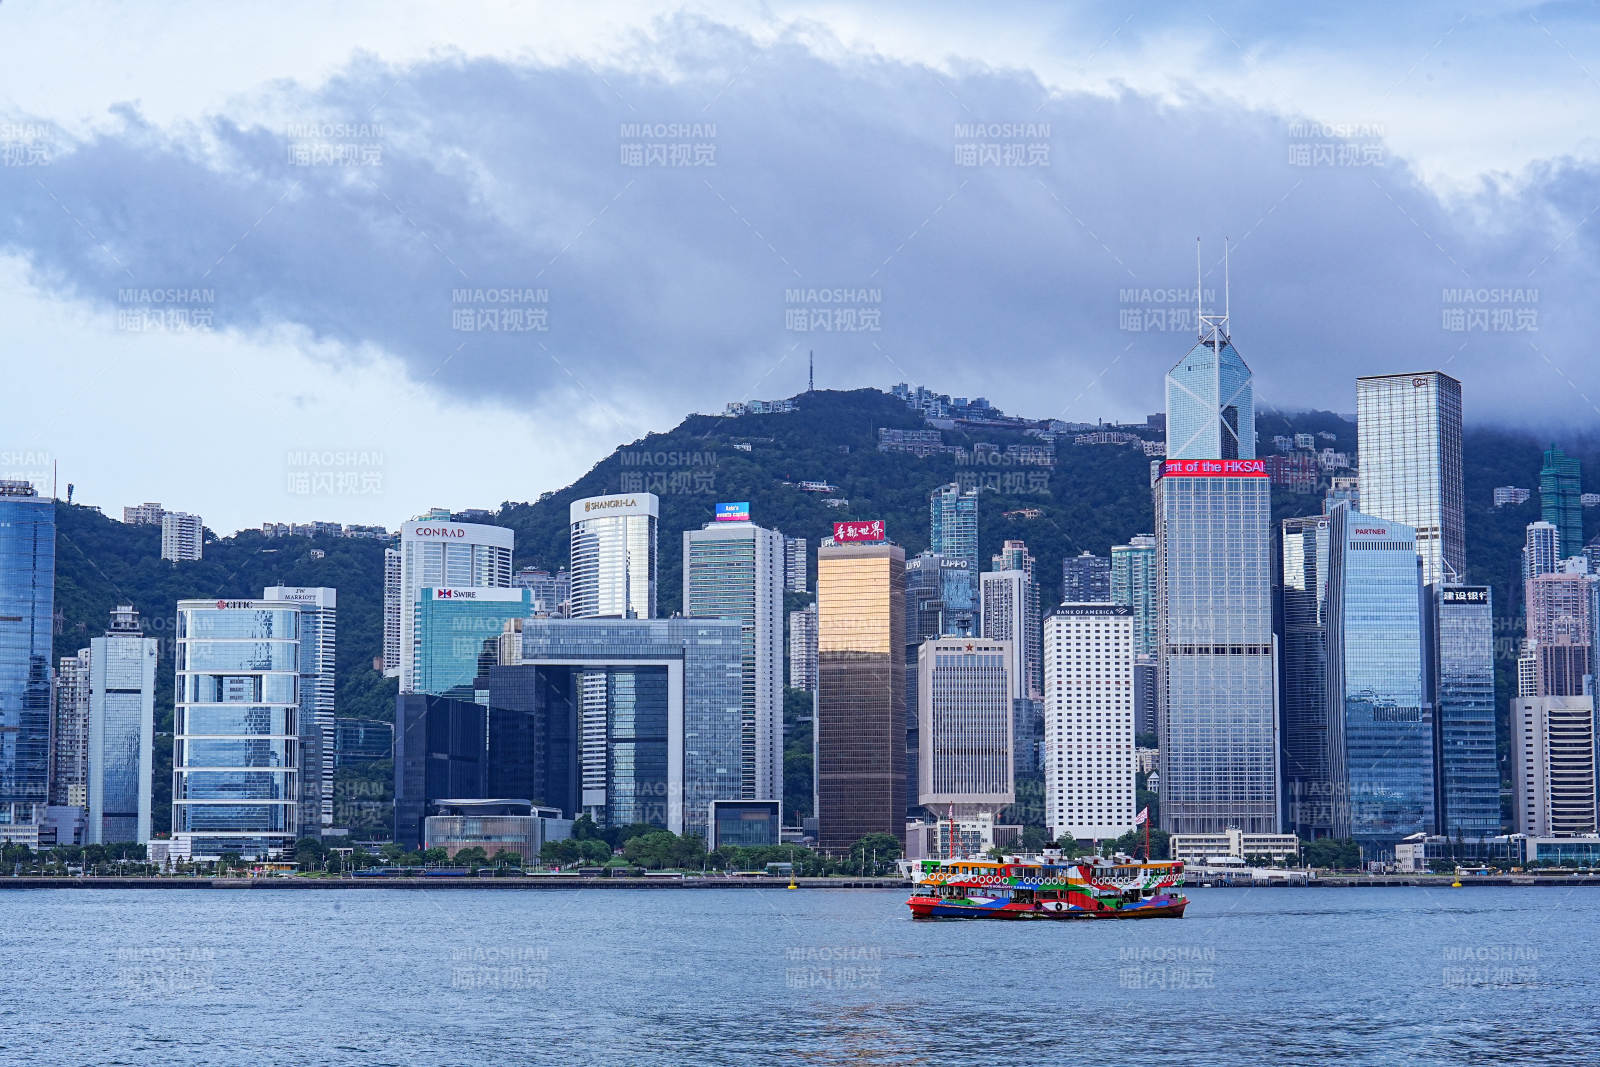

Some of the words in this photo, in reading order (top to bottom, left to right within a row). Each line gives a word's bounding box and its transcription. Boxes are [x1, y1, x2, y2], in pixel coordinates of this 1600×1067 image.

[1186, 462, 1199, 472] of
[1202, 462, 1222, 472] the
[591, 498, 637, 510] SHANGRI-LA
[416, 527, 465, 537] CONRAD
[941, 559, 968, 568] LIPPO
[226, 600, 254, 609] CITIC
